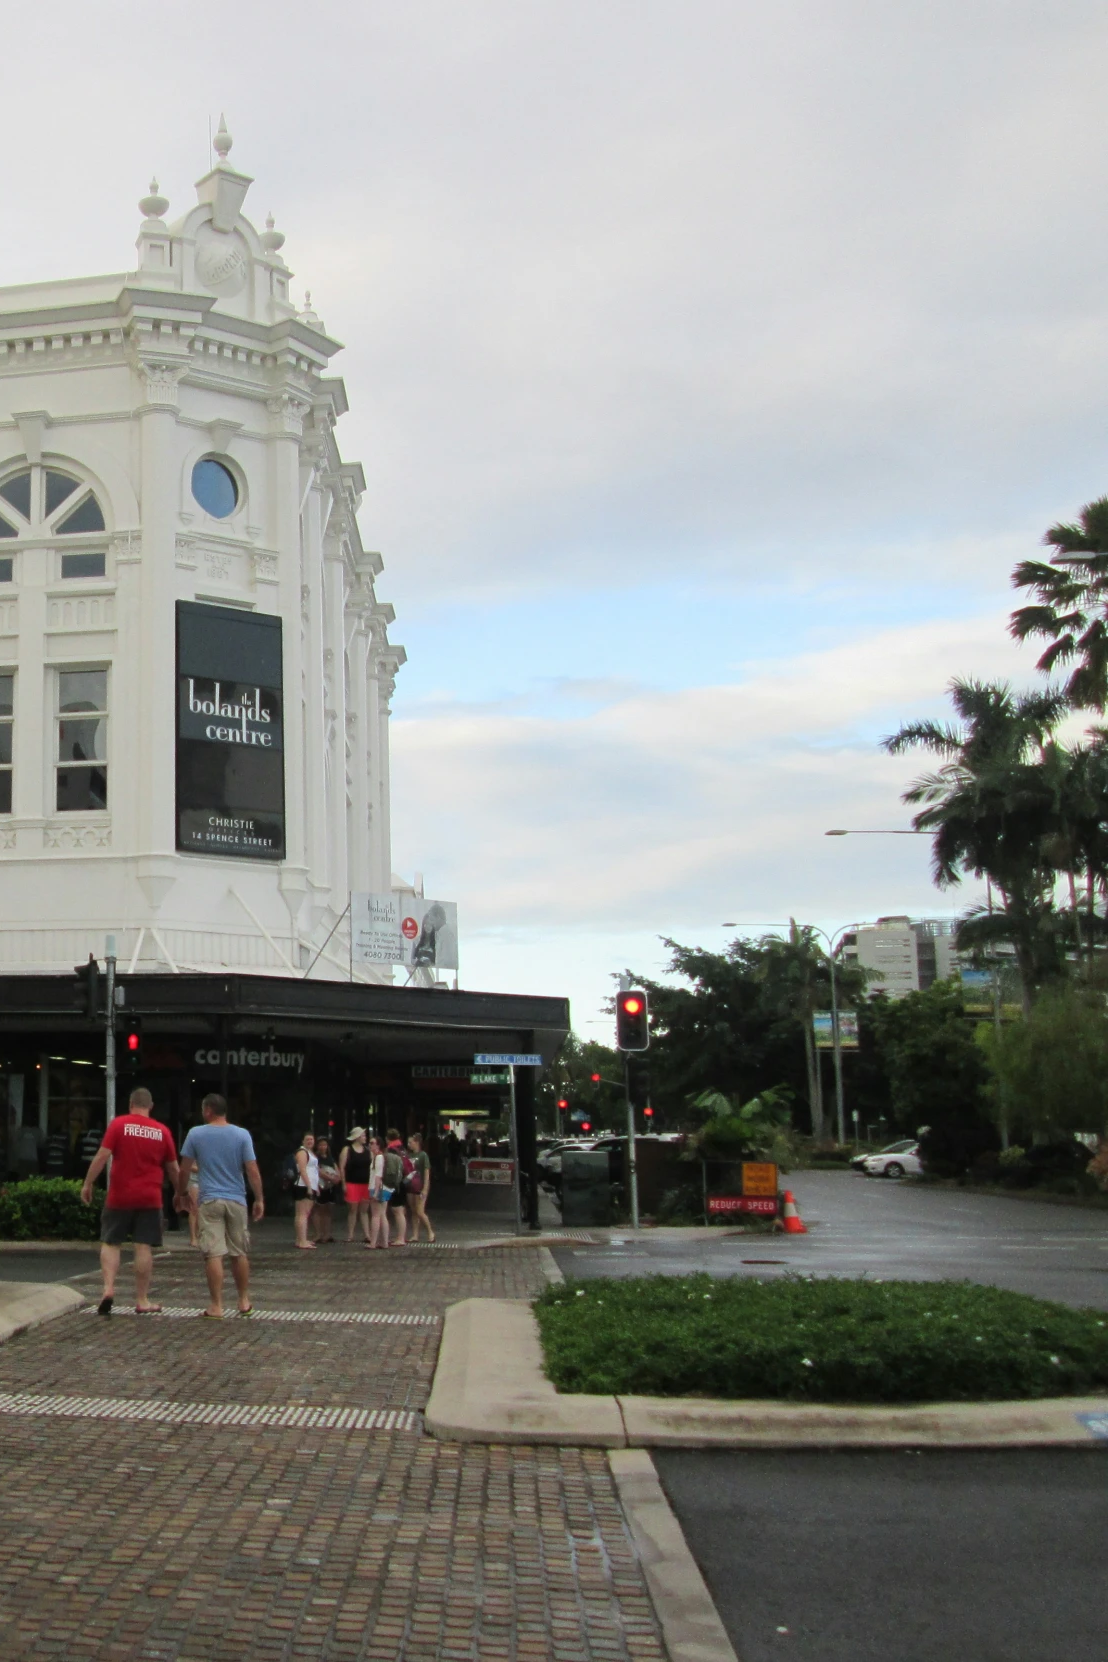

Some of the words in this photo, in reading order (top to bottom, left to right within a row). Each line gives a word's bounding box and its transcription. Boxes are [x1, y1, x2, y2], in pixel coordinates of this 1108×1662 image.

[188, 677, 270, 723] bolands
[206, 725, 272, 747] centre
[208, 816, 255, 830] CHRISTIE
[192, 831, 202, 839] 14
[205, 833, 239, 843] SPENCE
[243, 836, 272, 846] STREET
[363, 951, 382, 959] 4080
[383, 952, 402, 960] 7300
[194, 1045, 305, 1073] canterbury
[513, 1056, 540, 1064] TOILETS
[479, 1075, 497, 1083] LAKE
[124, 1126, 162, 1142] FREEDOM
[709, 1200, 742, 1209] REDUCE
[747, 1201, 775, 1211] SPEED
